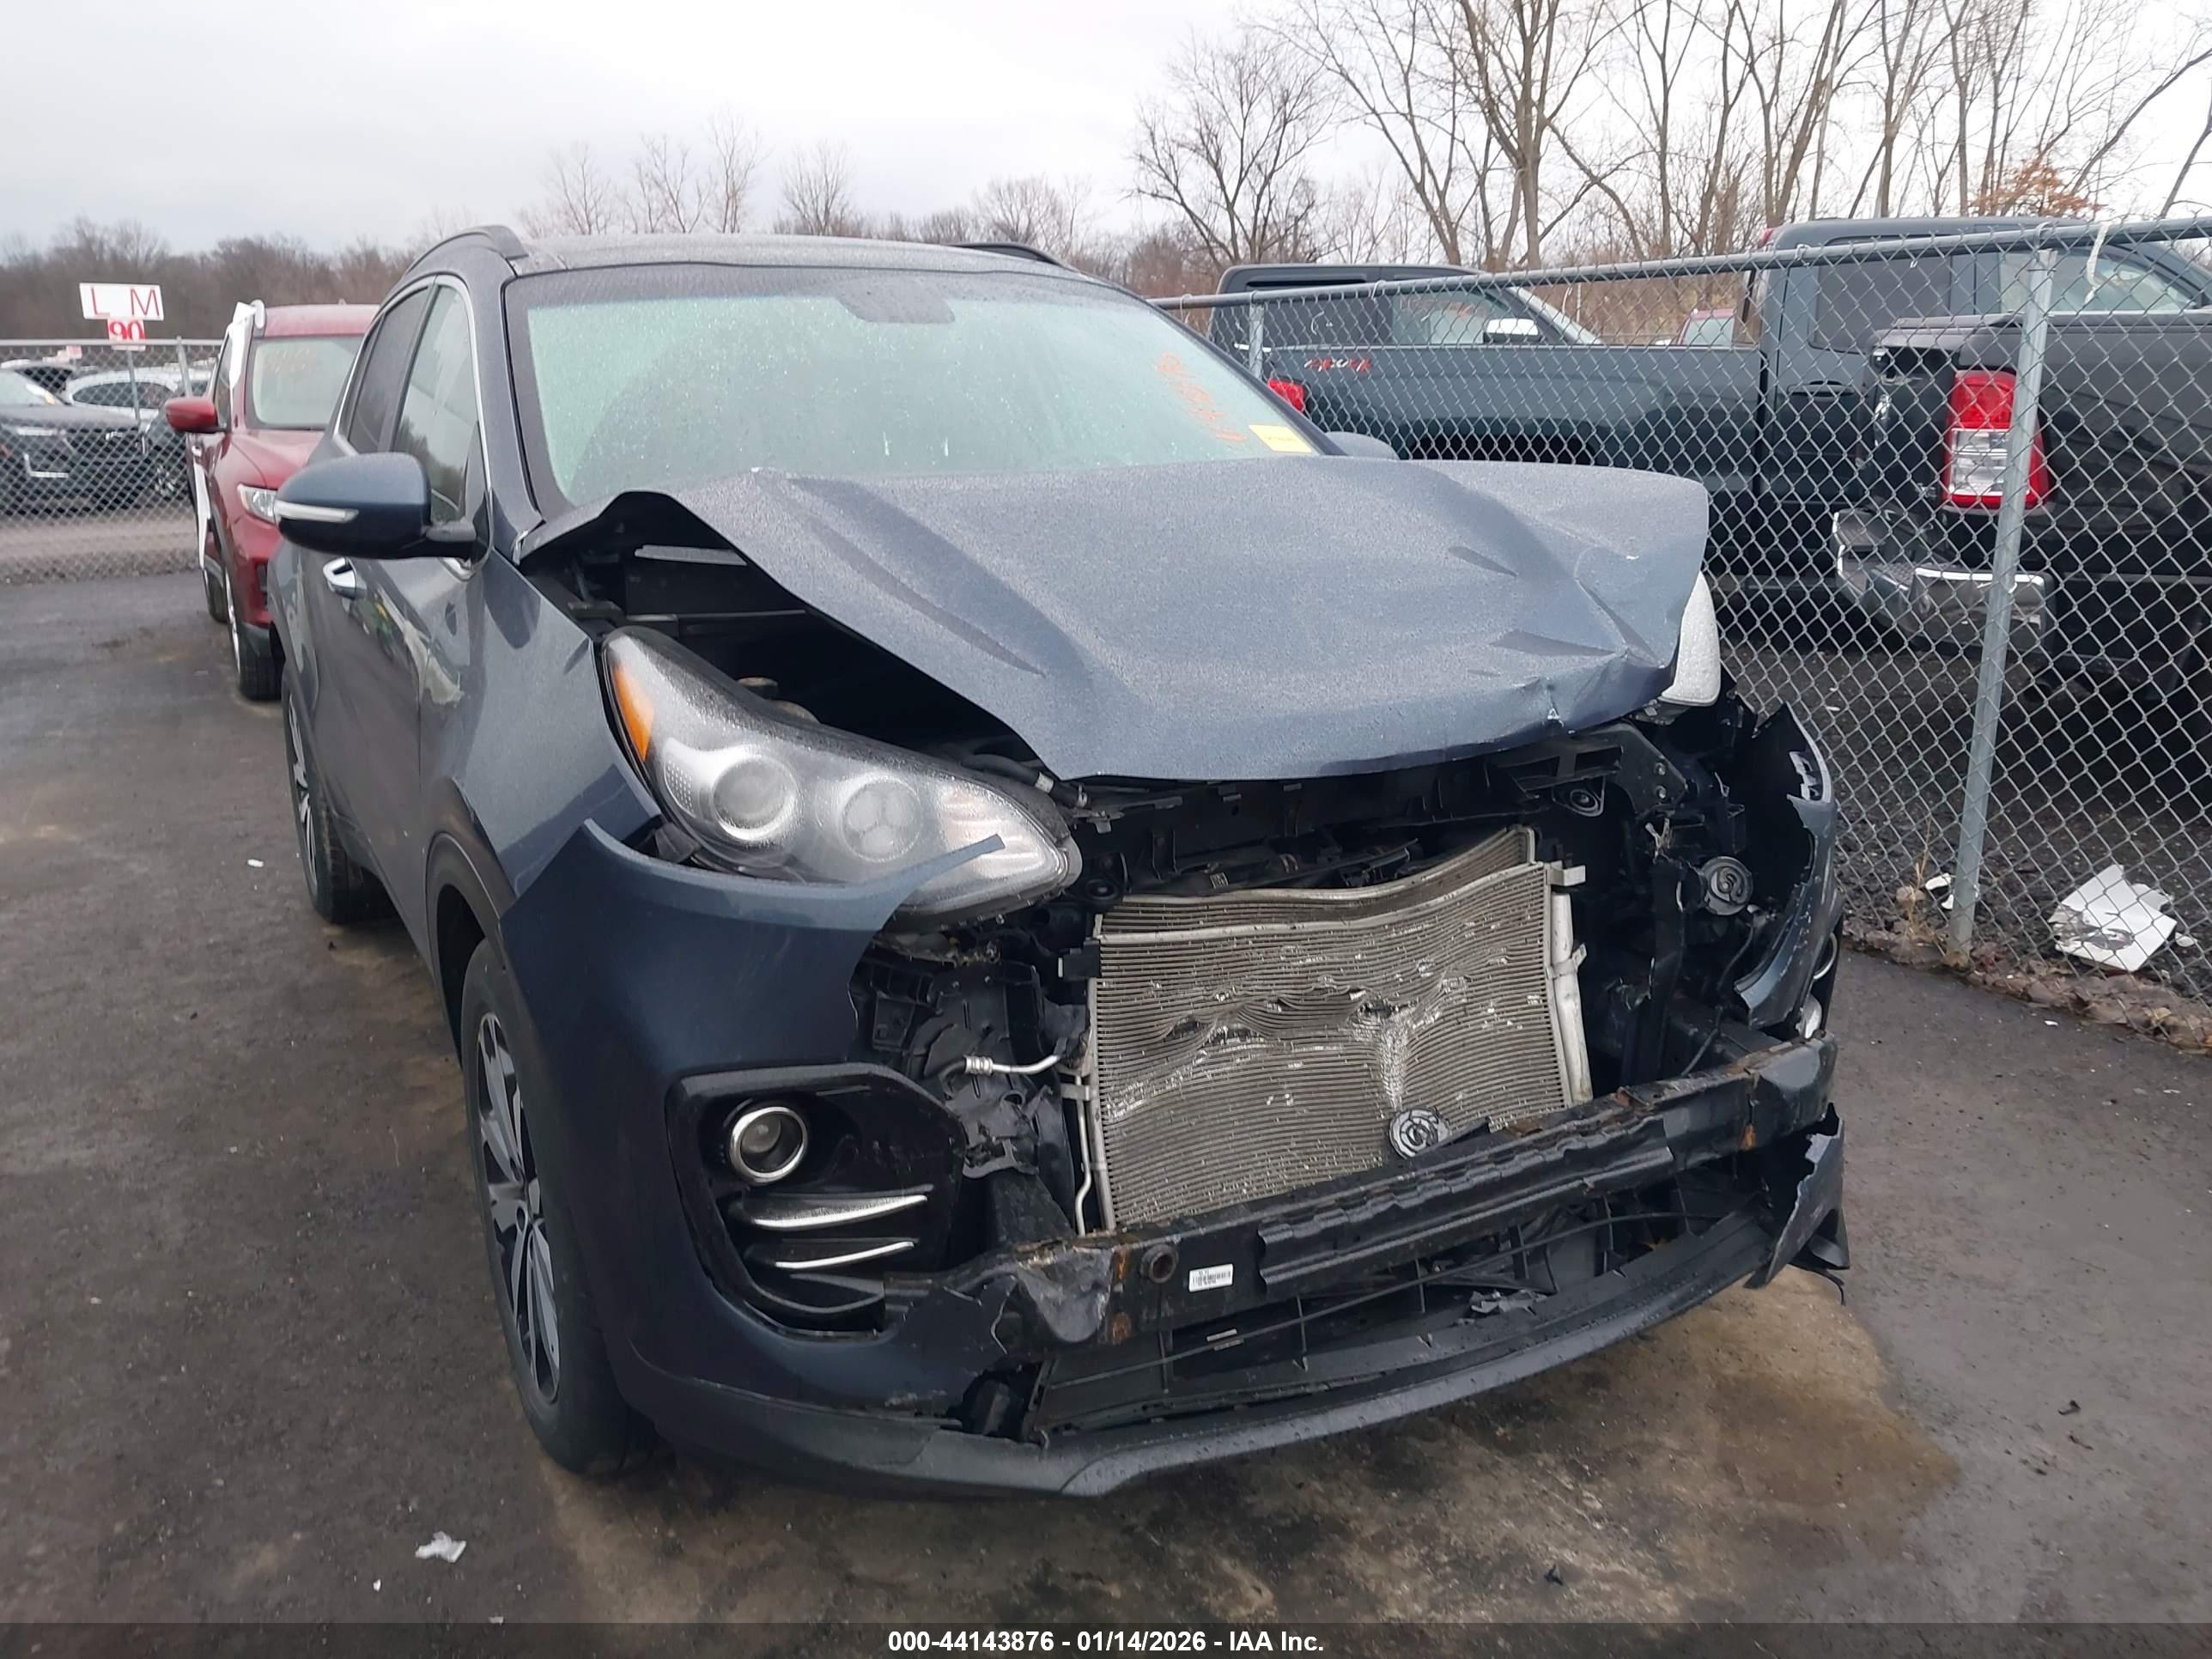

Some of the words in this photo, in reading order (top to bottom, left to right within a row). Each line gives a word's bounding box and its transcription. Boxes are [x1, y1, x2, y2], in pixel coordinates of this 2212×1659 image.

[90, 287, 111, 316] L
[130, 288, 161, 317] M
[108, 320, 146, 341] 90
